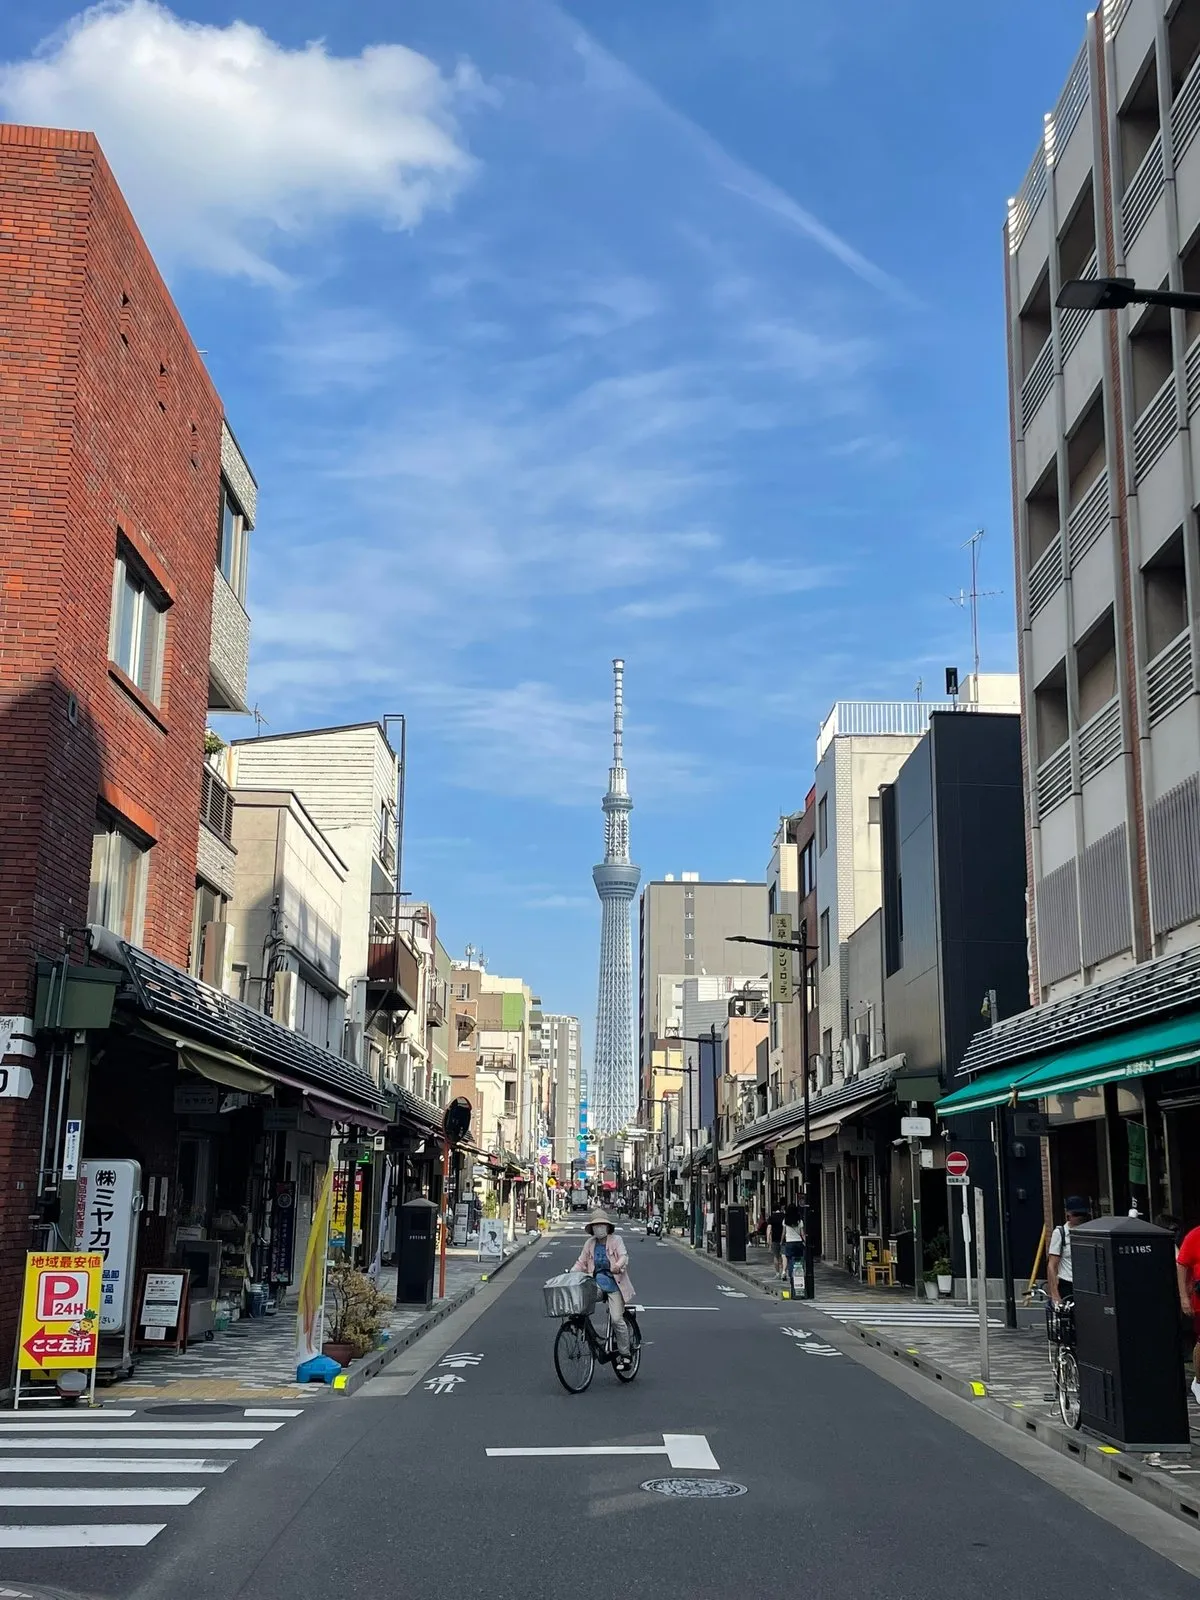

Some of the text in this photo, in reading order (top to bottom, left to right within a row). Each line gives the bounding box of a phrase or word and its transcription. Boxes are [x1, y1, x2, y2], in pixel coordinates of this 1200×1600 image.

[31, 1256, 101, 1269] 地域最安値
[42, 1275, 79, 1317] P
[54, 1302, 84, 1316] 24H
[32, 1337, 91, 1353] ここ左折
